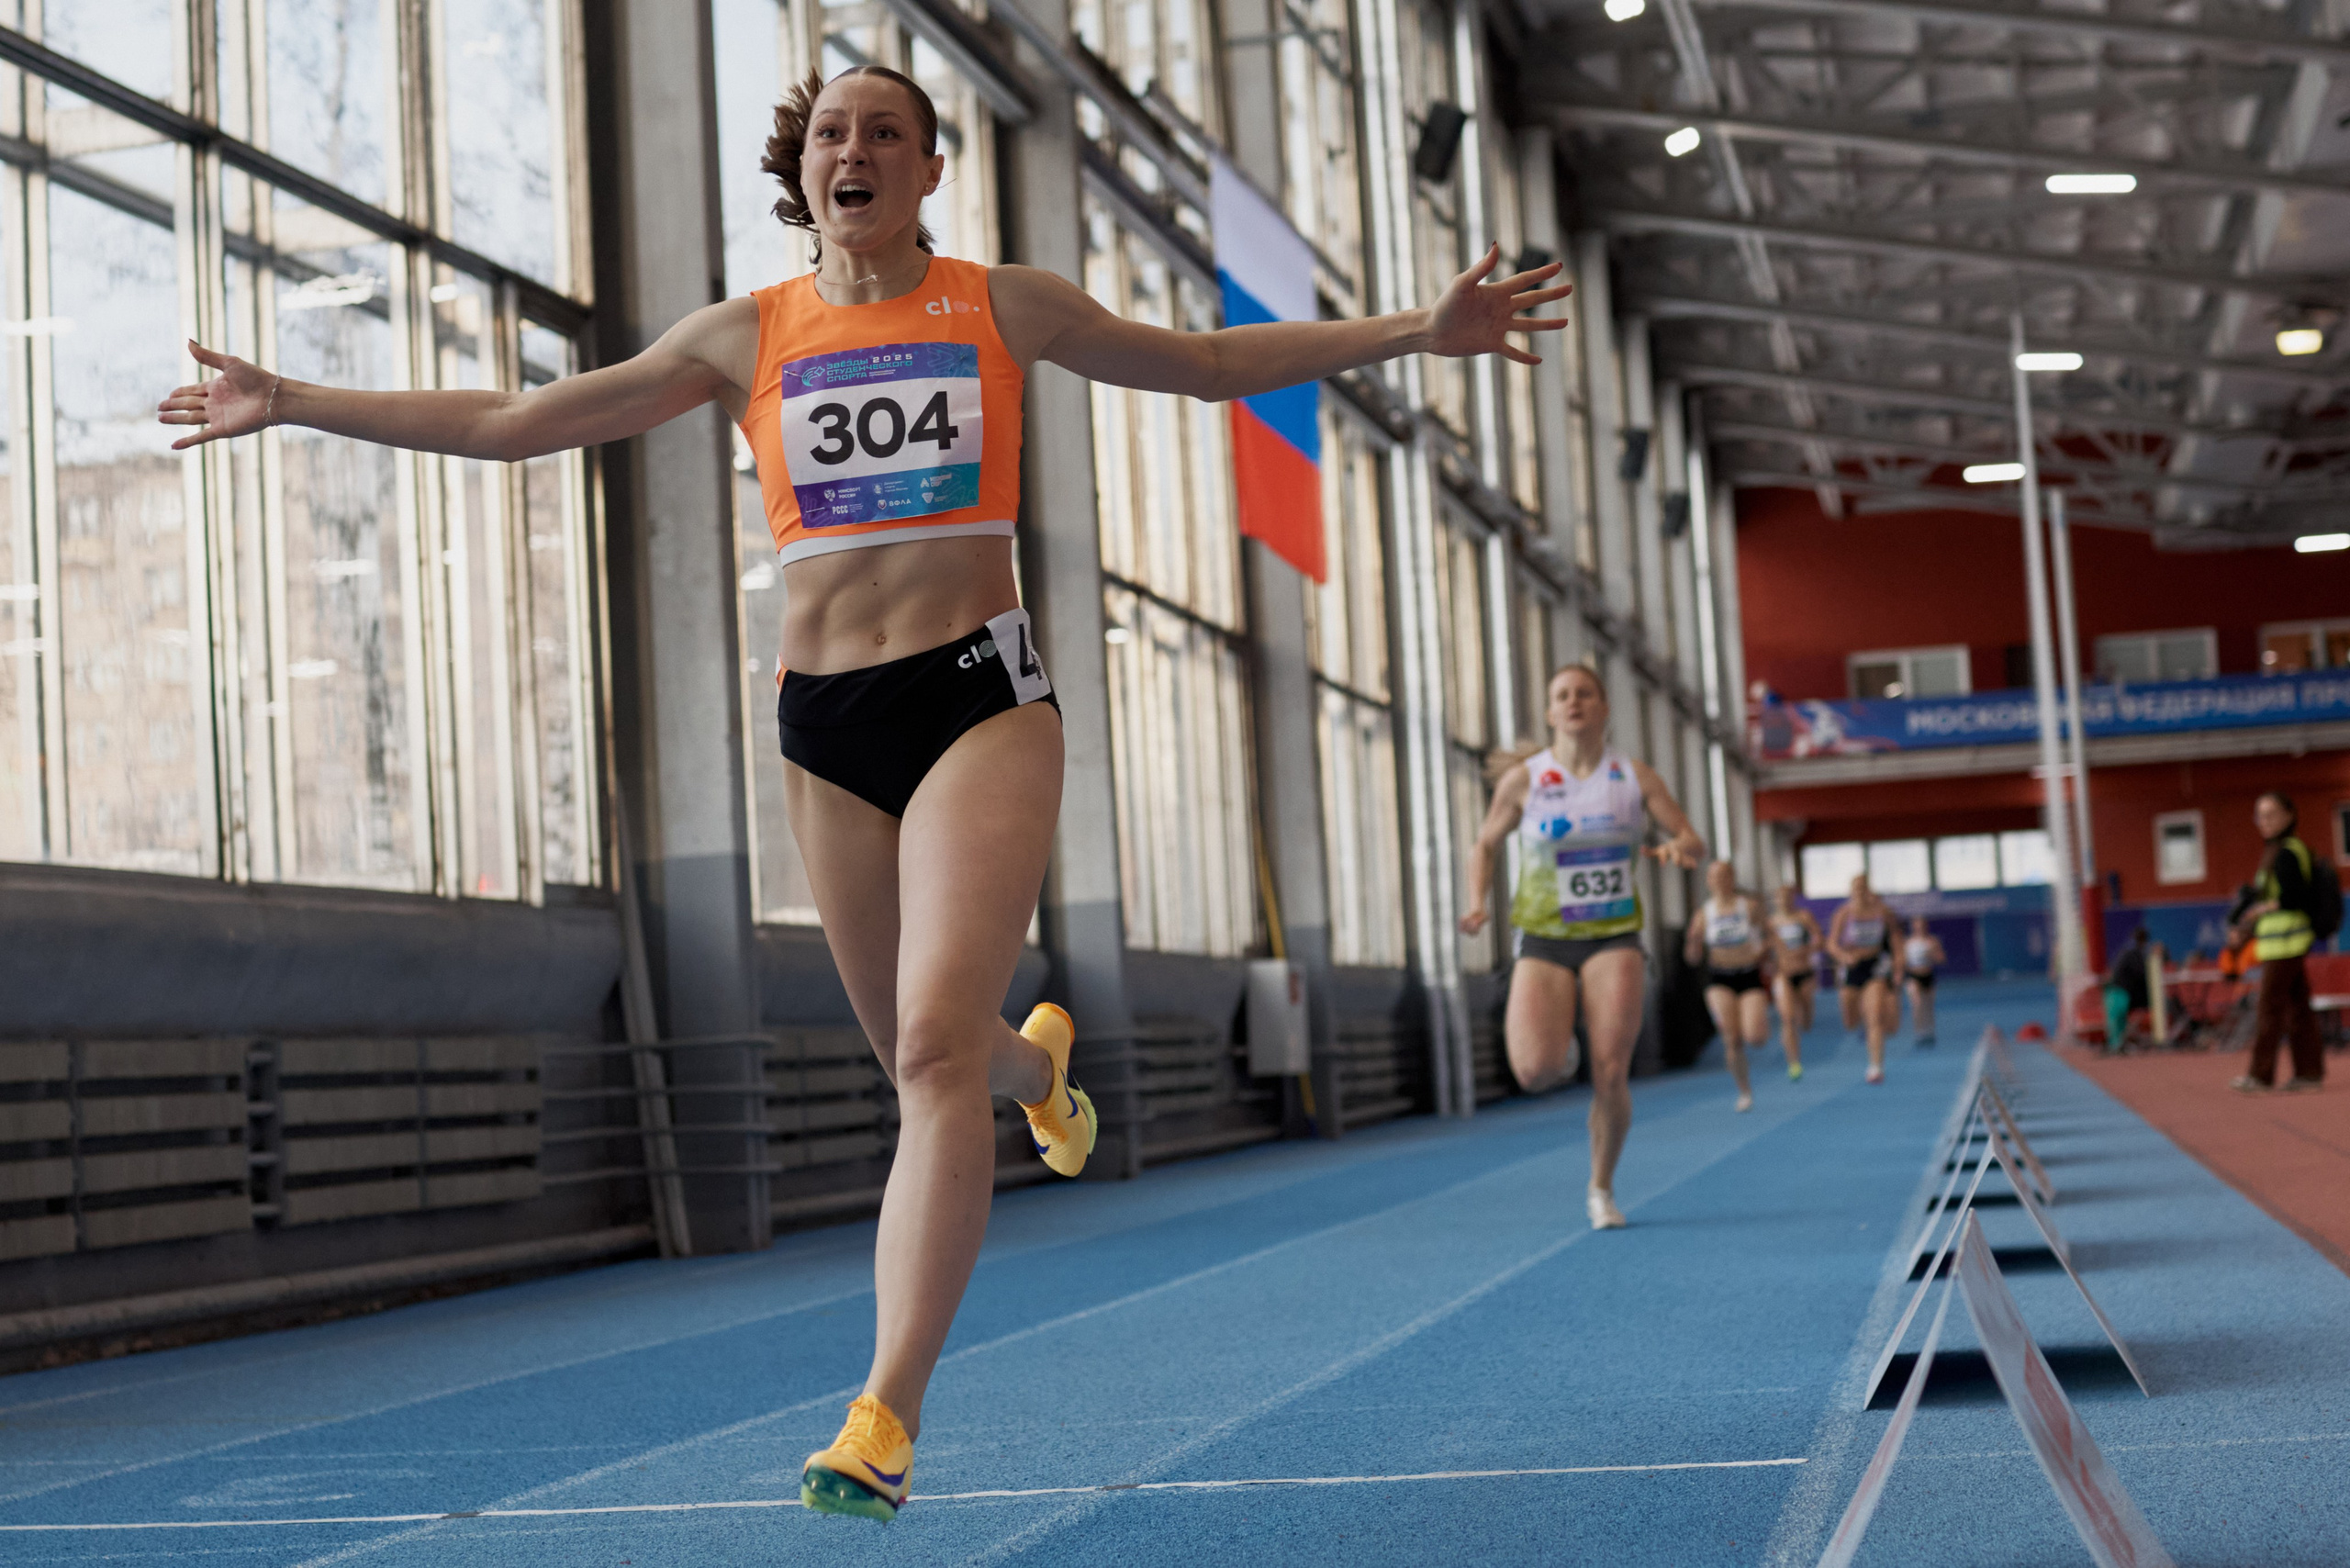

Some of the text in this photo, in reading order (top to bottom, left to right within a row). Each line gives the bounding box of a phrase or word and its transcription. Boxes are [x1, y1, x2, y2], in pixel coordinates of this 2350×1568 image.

[872, 353, 913, 364] 2025
[826, 360, 913, 376] СТУДЕНЧЕСКОГО
[826, 372, 867, 383] СПОРТА
[808, 391, 959, 465] 304
[889, 498, 912, 507] ВФЛА
[832, 505, 849, 515] РССС
[1570, 868, 1624, 898] 632
